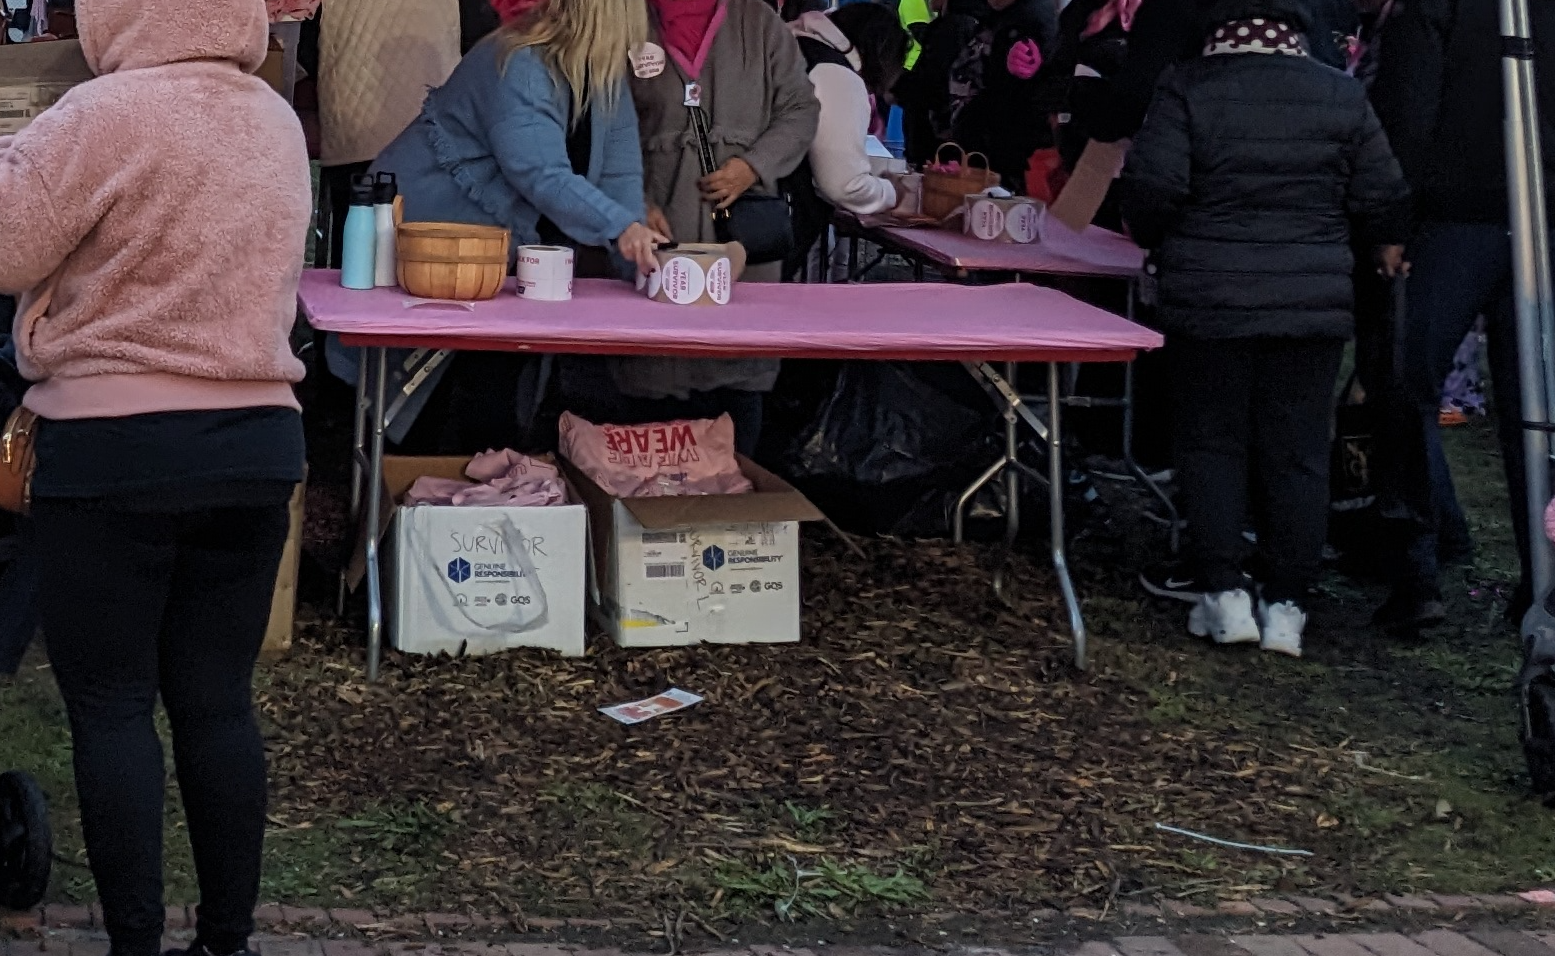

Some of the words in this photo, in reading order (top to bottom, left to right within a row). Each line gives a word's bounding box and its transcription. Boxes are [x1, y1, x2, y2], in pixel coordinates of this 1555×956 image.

[653, 424, 697, 453] WE
[450, 532, 548, 557] SURVIOR
[764, 581, 783, 591] GQS
[510, 595, 531, 605] GQS
